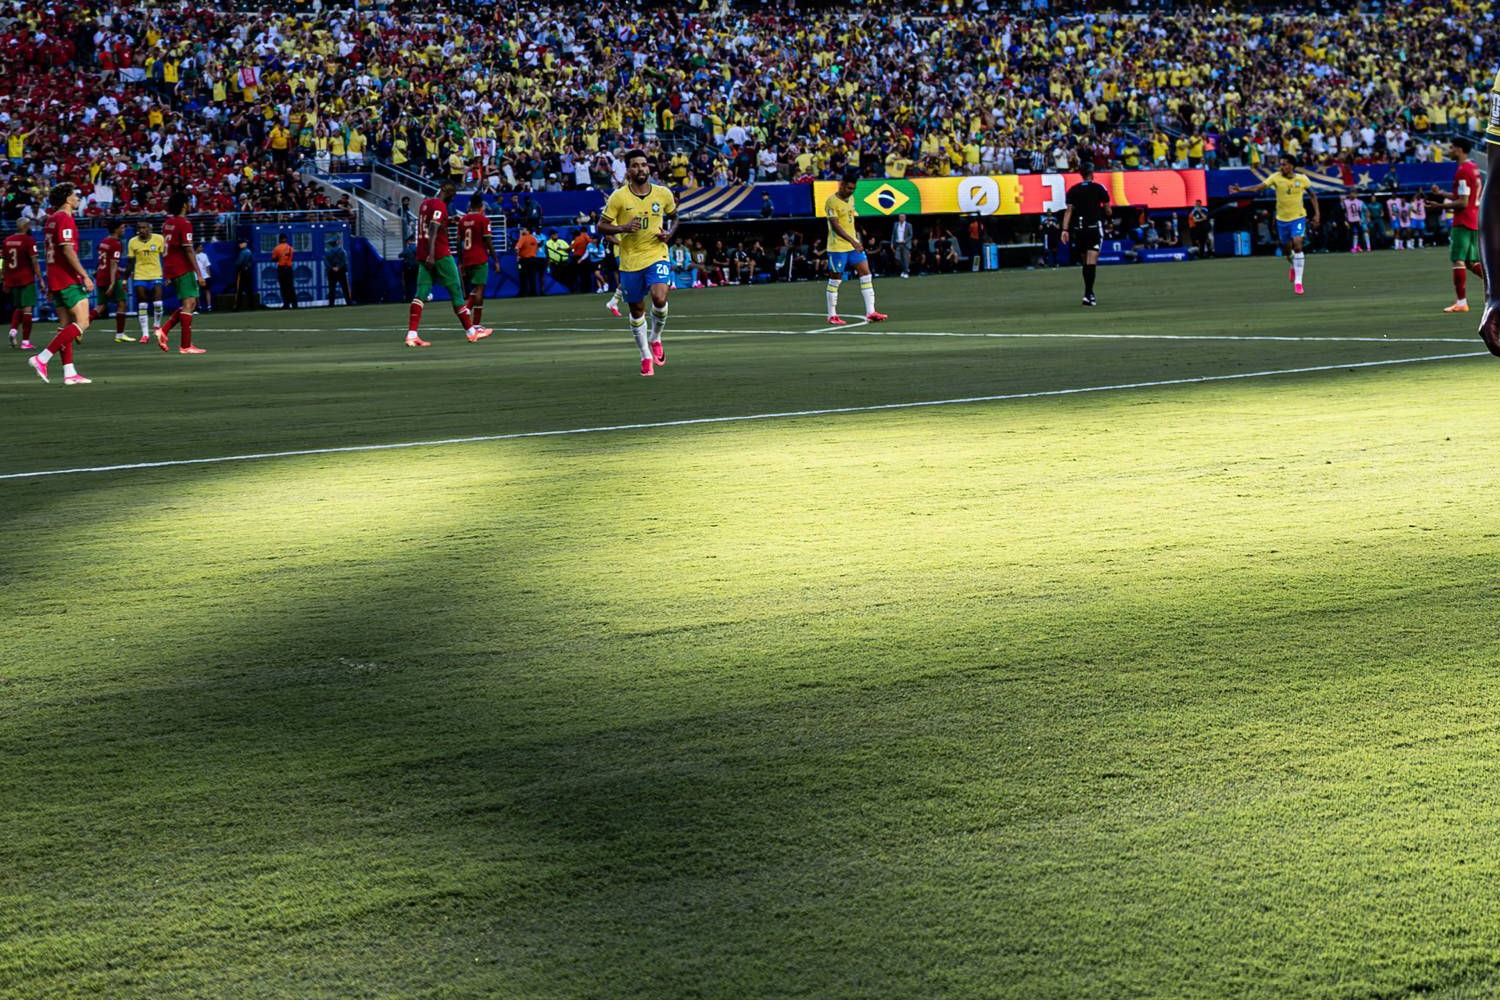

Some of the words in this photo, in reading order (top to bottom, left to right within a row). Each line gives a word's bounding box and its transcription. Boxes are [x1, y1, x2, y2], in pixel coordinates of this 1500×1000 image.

[958, 176, 1000, 215] 0
[464, 228, 472, 250] 8
[9, 248, 17, 269] 3
[656, 263, 669, 276] 20
